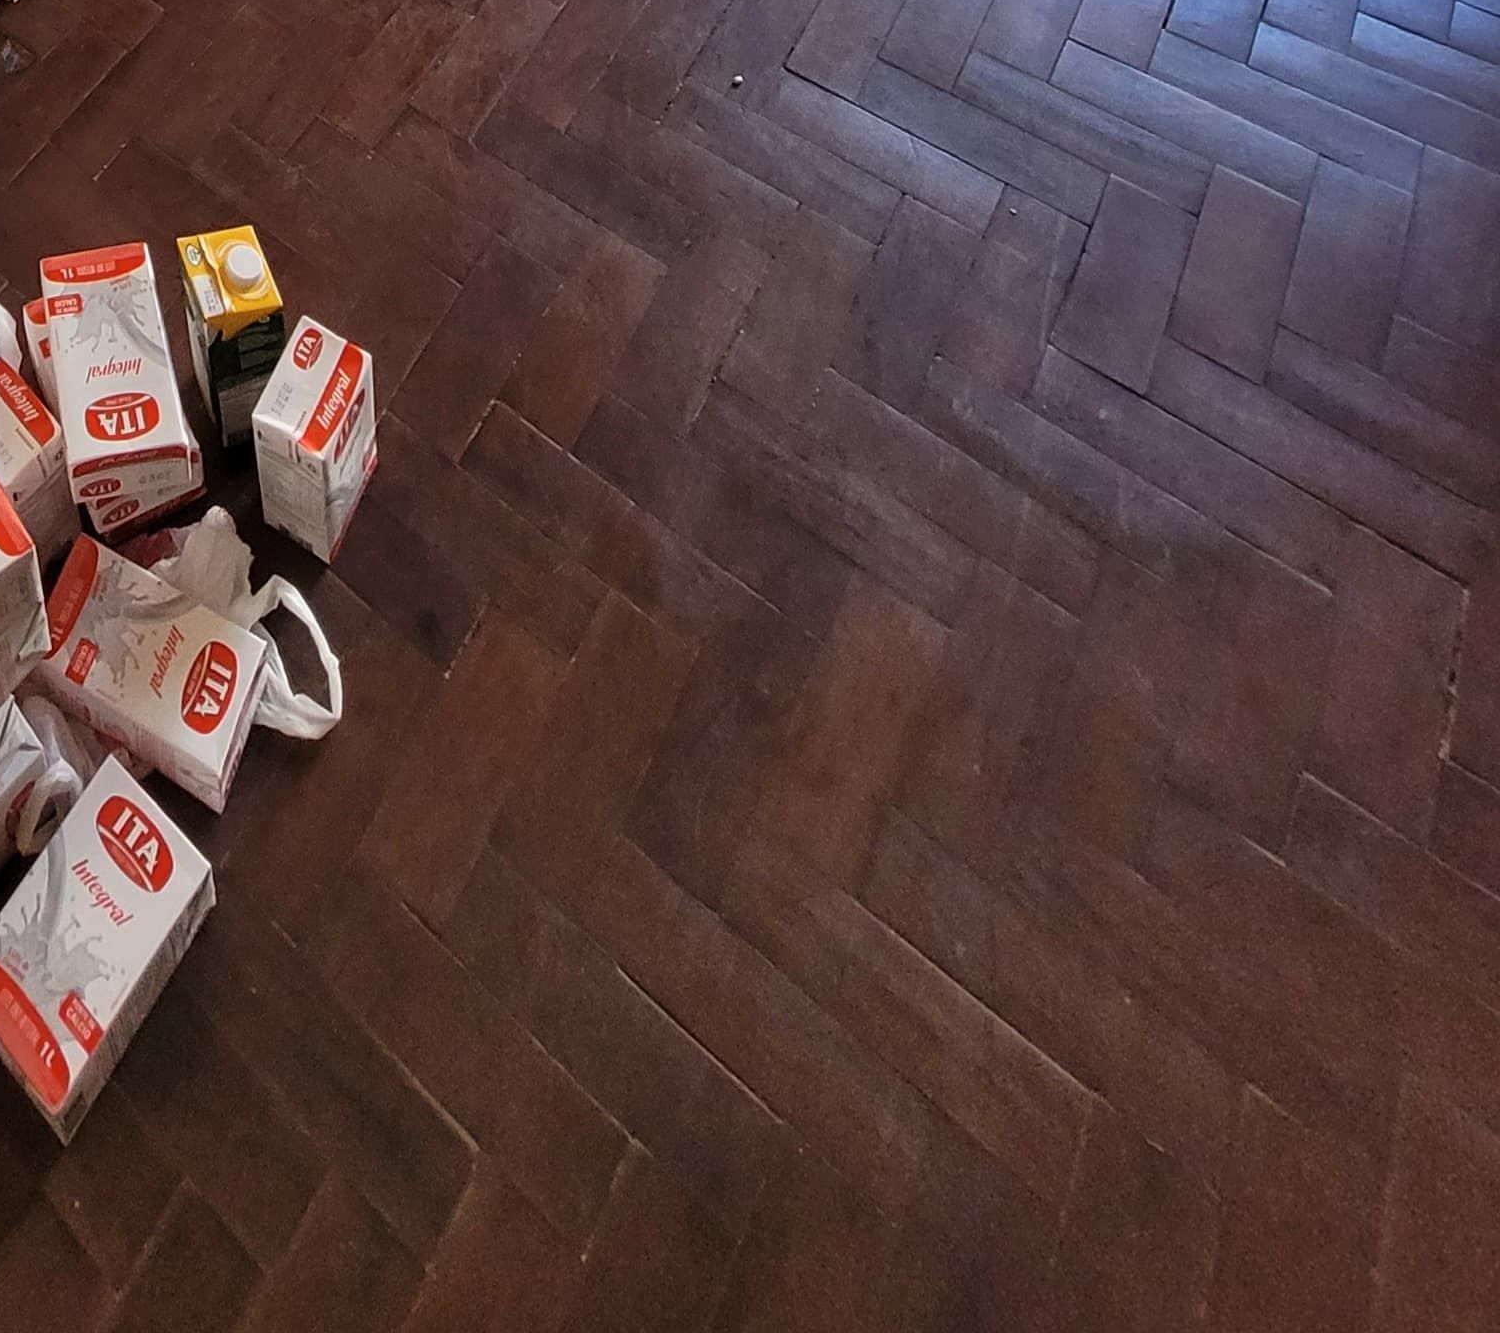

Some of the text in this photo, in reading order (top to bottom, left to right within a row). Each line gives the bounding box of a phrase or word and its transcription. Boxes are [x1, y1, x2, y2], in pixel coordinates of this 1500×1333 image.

[60, 267, 74, 281] 1L
[296, 336, 317, 362] ITA
[85, 356, 143, 384] Integral
[315, 367, 352, 431] Integral
[97, 404, 146, 436] ITA
[150, 624, 186, 700] Integral
[193, 659, 233, 718] ITA
[111, 806, 162, 876] ITA
[70, 858, 135, 927] Integral
[65, 1008, 91, 1041] CALCIO
[38, 1040, 55, 1069] 1L
